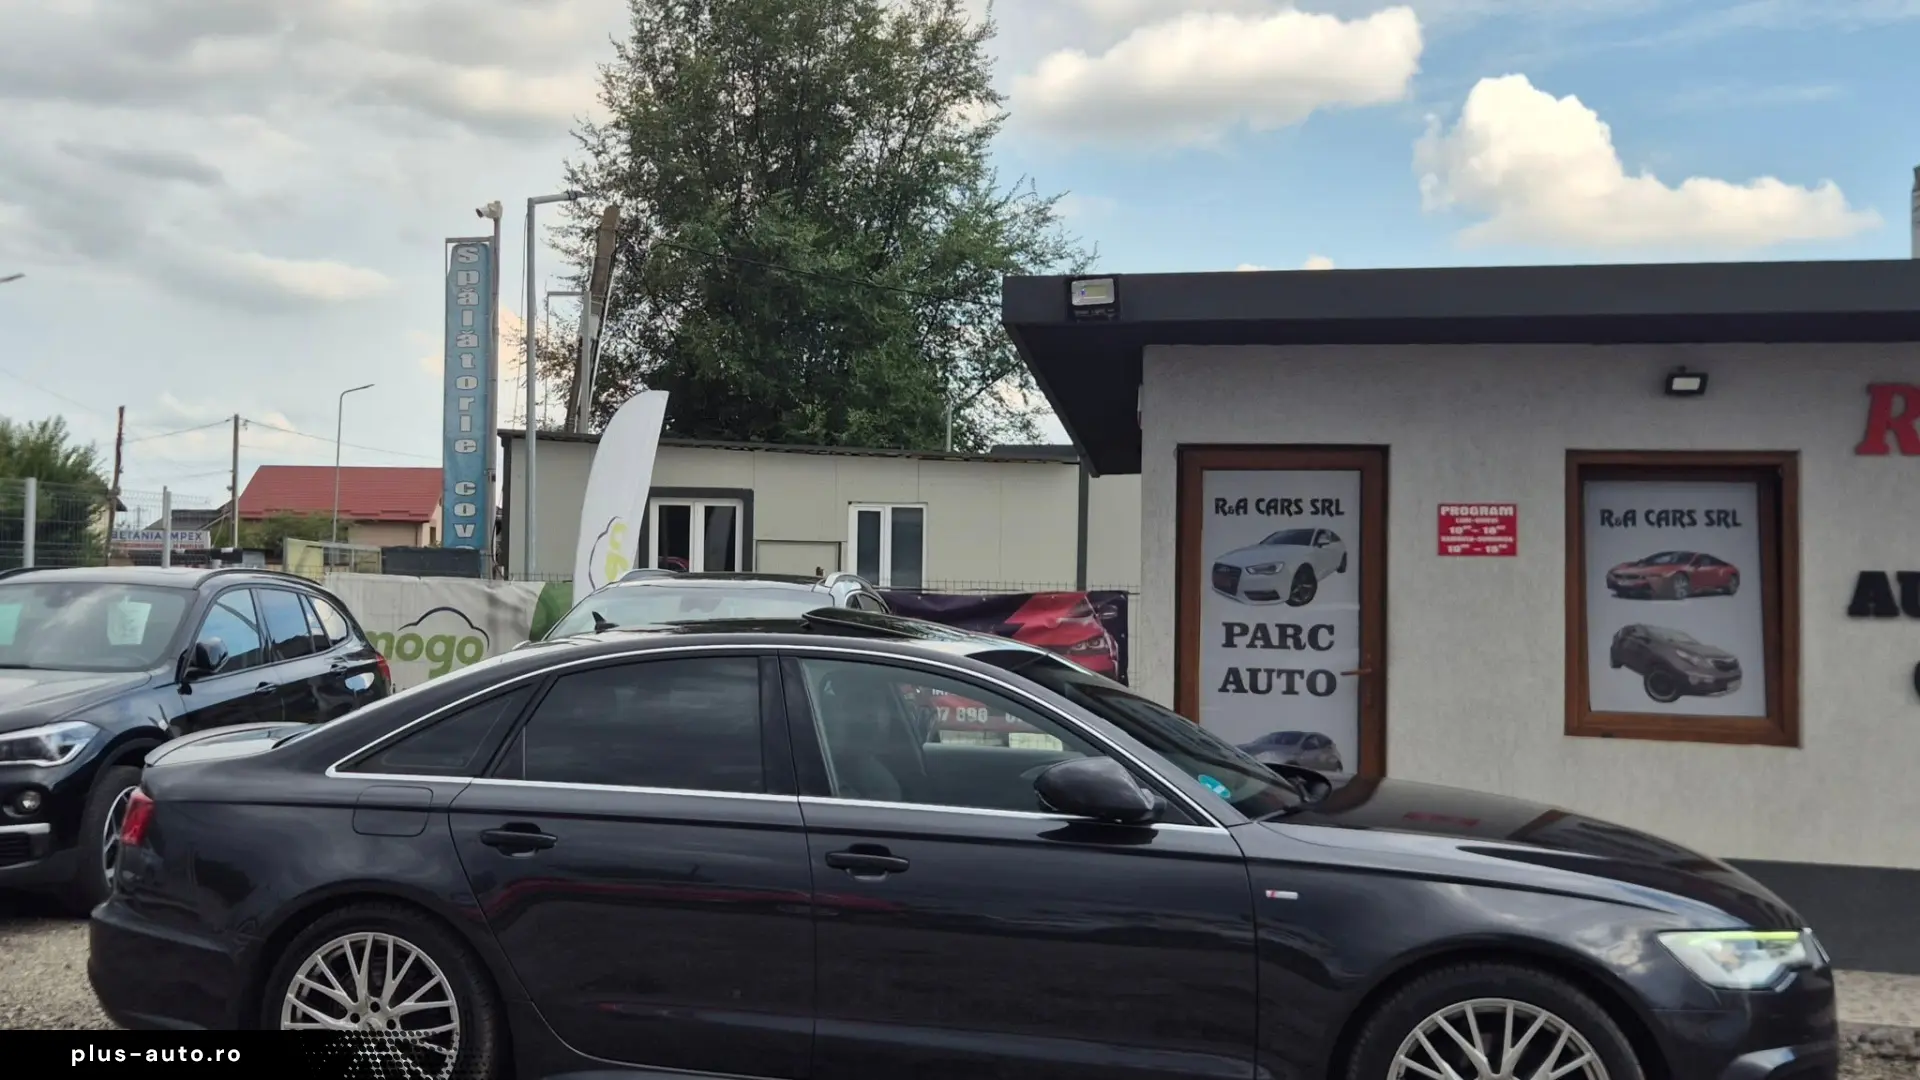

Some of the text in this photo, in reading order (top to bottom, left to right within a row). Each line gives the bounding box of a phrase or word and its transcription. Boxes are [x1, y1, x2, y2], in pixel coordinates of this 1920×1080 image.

[453, 480, 477, 550] cov
[1214, 497, 1345, 517] R&A CARS SRL
[1440, 505, 1514, 516] PROGRAM
[1600, 509, 1742, 528] R&A CARS SRL
[171, 531, 202, 541] MPEX
[1221, 622, 1335, 651] PARC
[1218, 667, 1337, 697] AUTO
